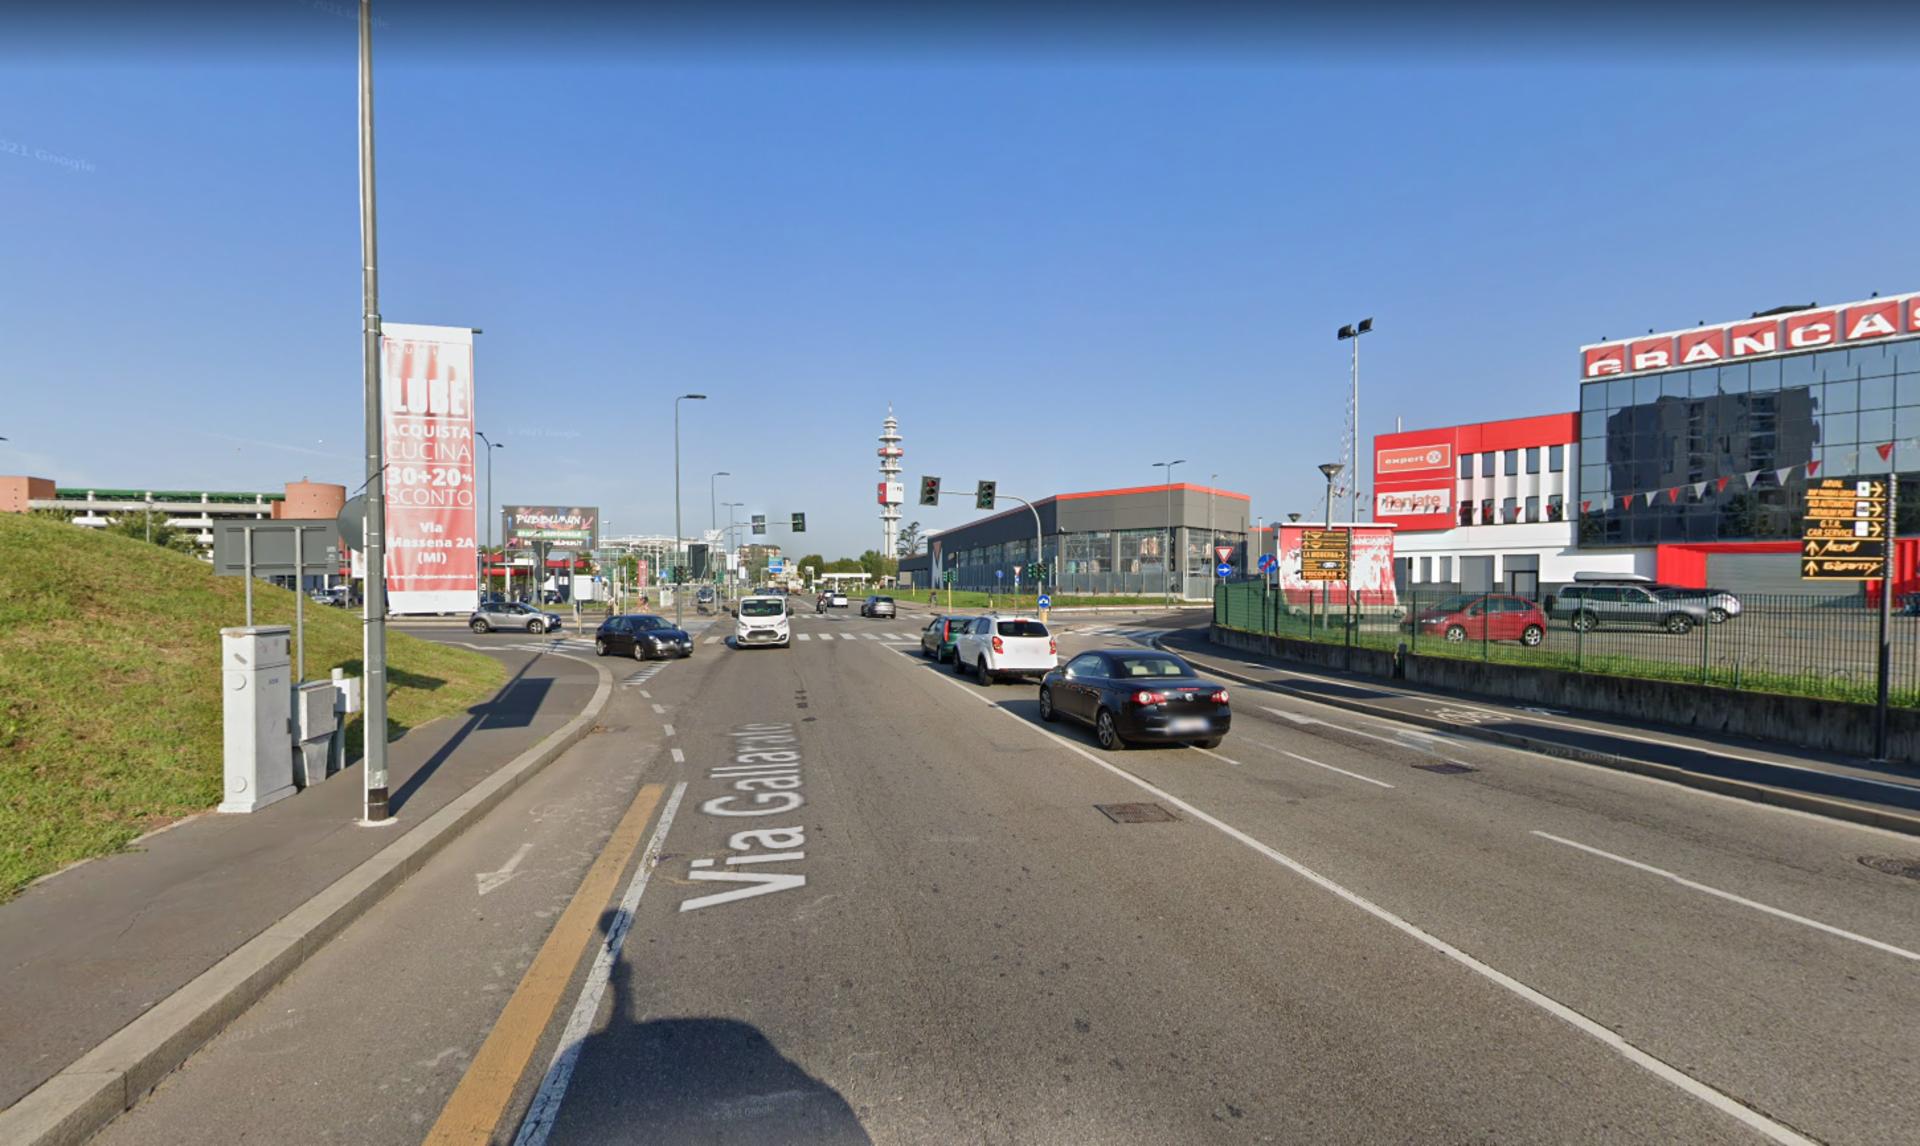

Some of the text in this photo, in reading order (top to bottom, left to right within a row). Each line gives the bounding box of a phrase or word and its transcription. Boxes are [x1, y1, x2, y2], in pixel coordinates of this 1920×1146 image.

[1588, 307, 1920, 376] GRANCA
[390, 377, 466, 415] LUBE
[388, 423, 472, 439] ACQUISTA
[387, 440, 472, 461] CUCINA
[1385, 454, 1425, 465] expert
[387, 488, 473, 507] SCONTO
[419, 522, 444, 533] Via
[1823, 529, 1854, 537] SERVICE
[388, 537, 475, 548] Massena 2A
[417, 552, 447, 565] (MI)
